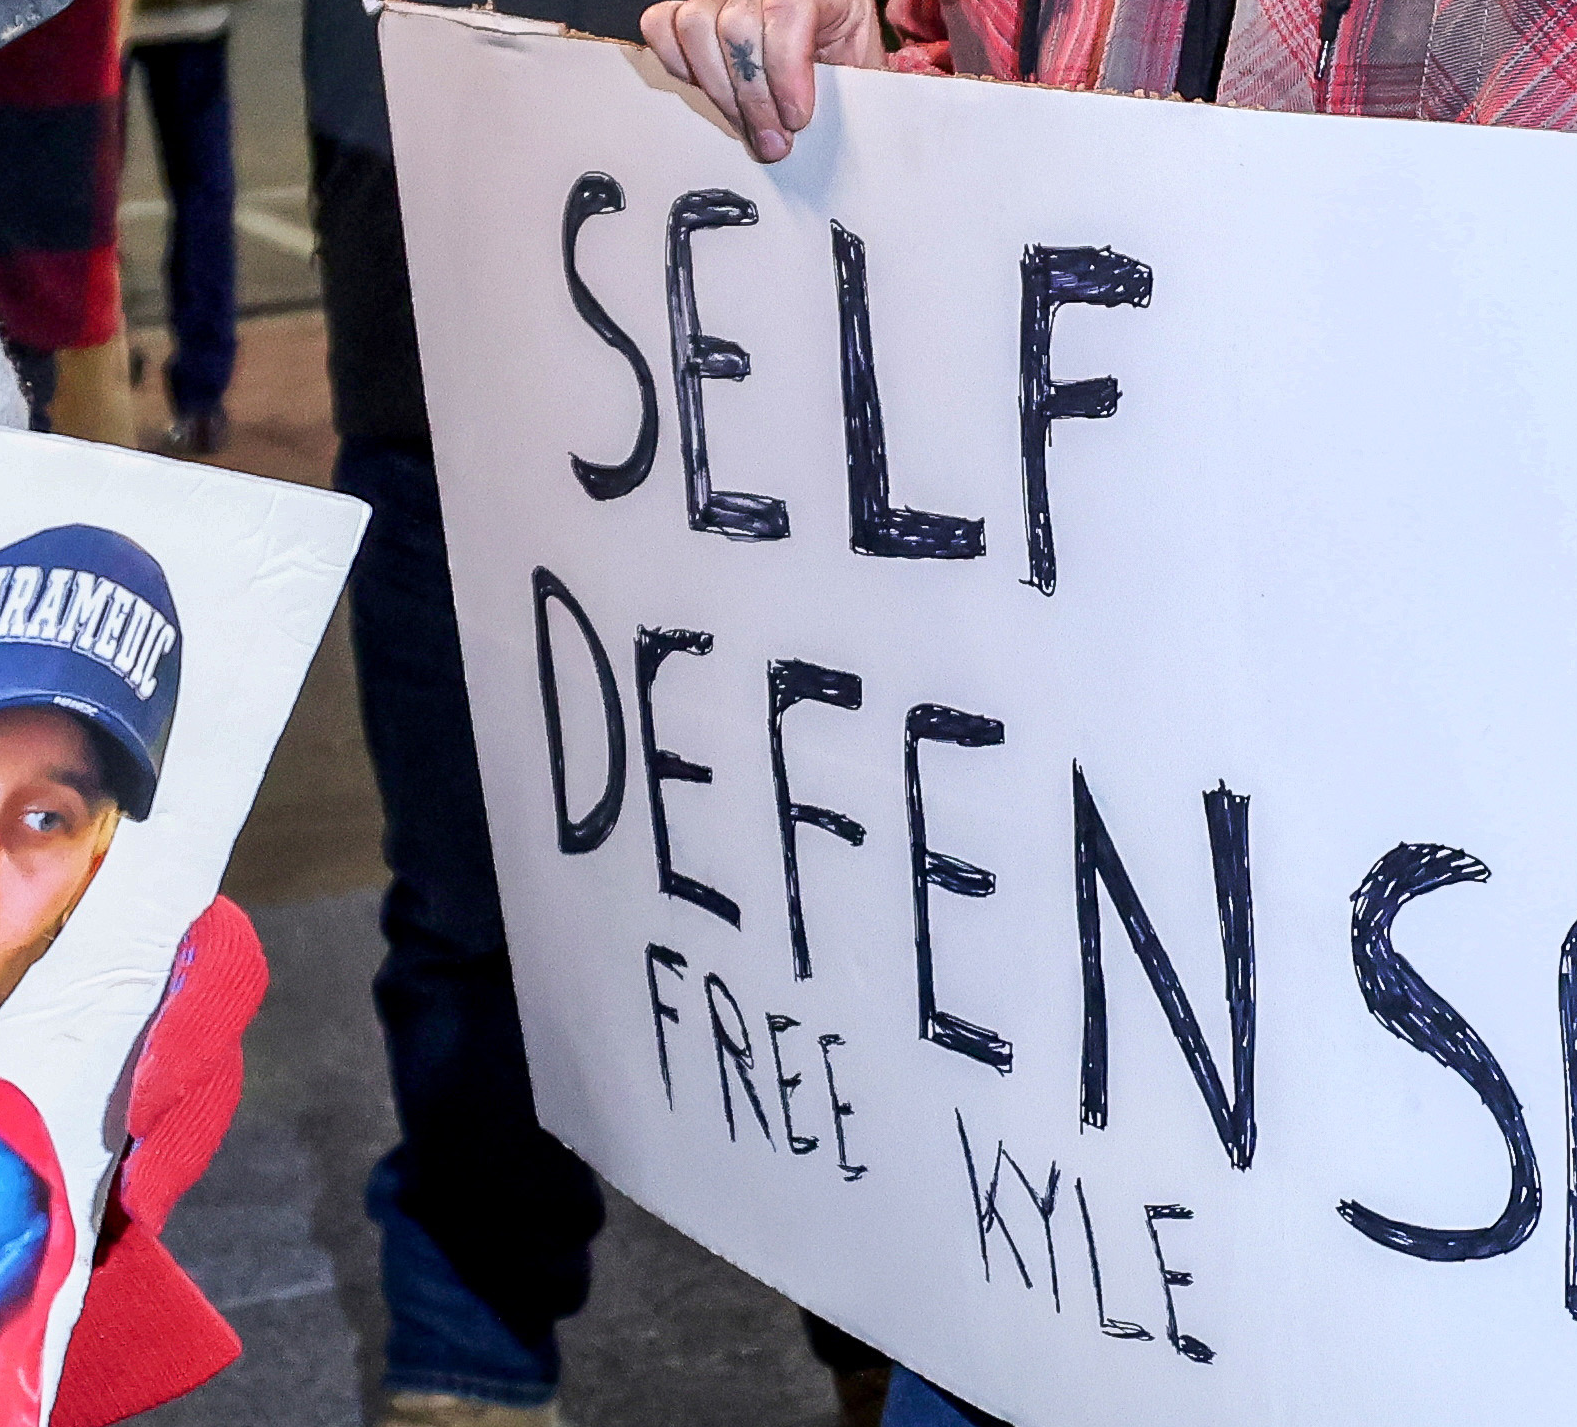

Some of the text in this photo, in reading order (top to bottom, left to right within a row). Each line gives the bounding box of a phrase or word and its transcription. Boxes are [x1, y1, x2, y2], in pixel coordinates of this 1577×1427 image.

[561, 170, 1154, 597] SELF
[644, 940, 1217, 1365] FREE KYLE
